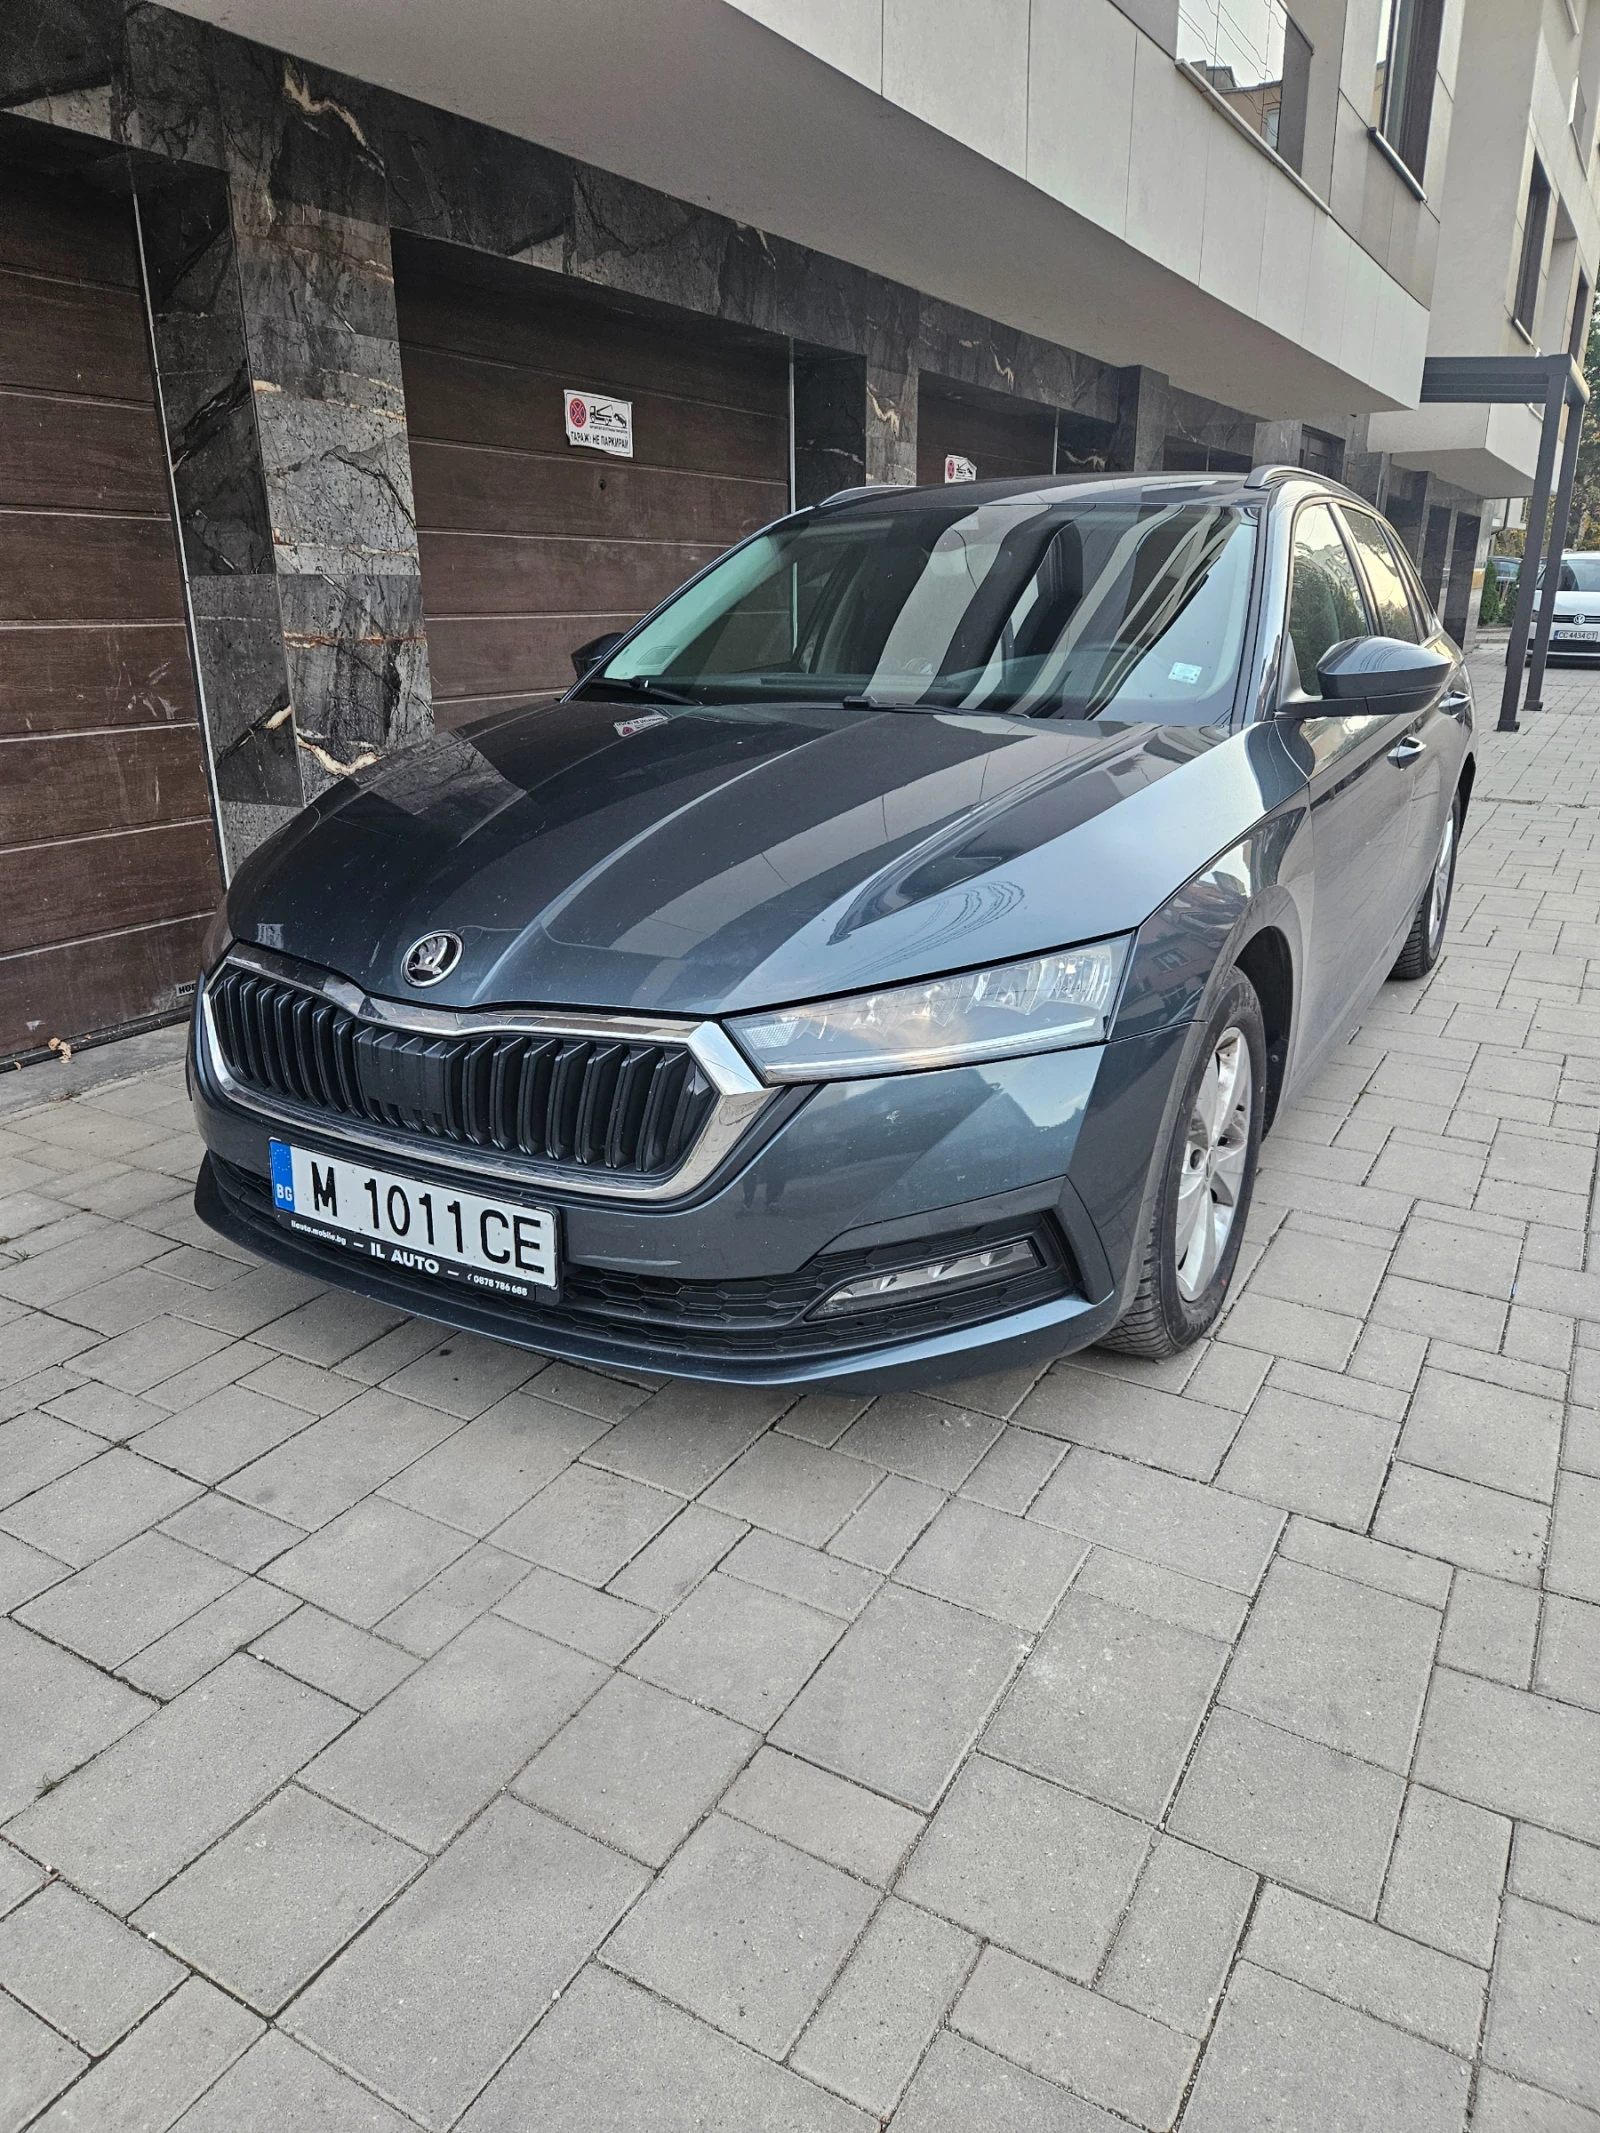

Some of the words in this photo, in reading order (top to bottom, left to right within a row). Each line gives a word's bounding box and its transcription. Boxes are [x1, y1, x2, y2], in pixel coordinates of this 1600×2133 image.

[592, 433, 600, 445] НЕ
[600, 436, 629, 449] ПАРКИРАЙ
[276, 1183, 293, 1202] BG
[311, 1161, 338, 1217] M
[371, 1241, 386, 1259] IL
[391, 1248, 440, 1275] AUTO
[473, 1275, 495, 1288] 0878
[495, 1280, 511, 1292] 786
[511, 1283, 528, 1297] 688
